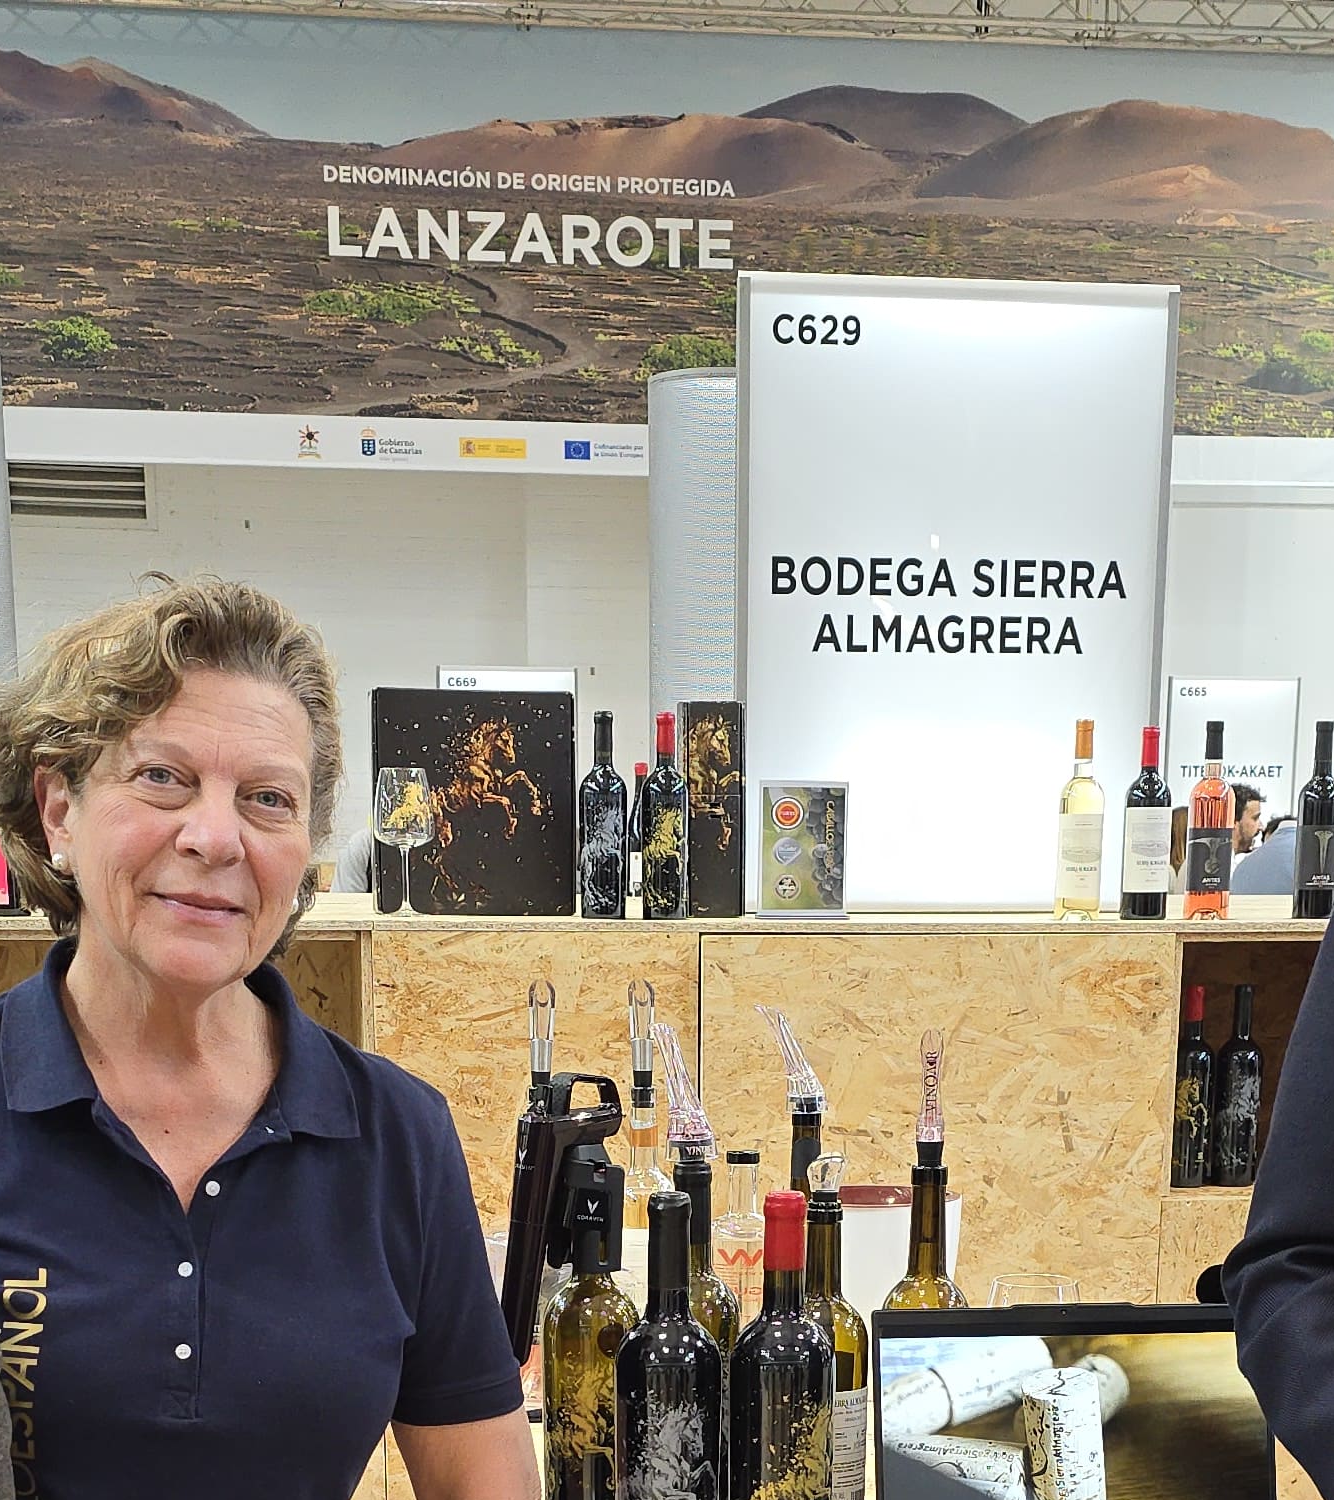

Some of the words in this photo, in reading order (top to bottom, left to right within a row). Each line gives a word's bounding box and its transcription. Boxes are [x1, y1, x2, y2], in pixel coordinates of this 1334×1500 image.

[322, 165, 491, 189] DENOMINACIÓN
[497, 171, 525, 190] DE
[530, 173, 611, 193] ORIGEN
[617, 176, 736, 198] PROTEGIDA
[327, 205, 734, 270] LANZAROTE
[772, 313, 862, 346] C629
[771, 556, 957, 597] BODEGA
[972, 558, 1127, 599] SIERRA
[812, 613, 1084, 655] ALMAGRERA
[447, 676, 477, 688] C669
[1179, 687, 1207, 697] C665
